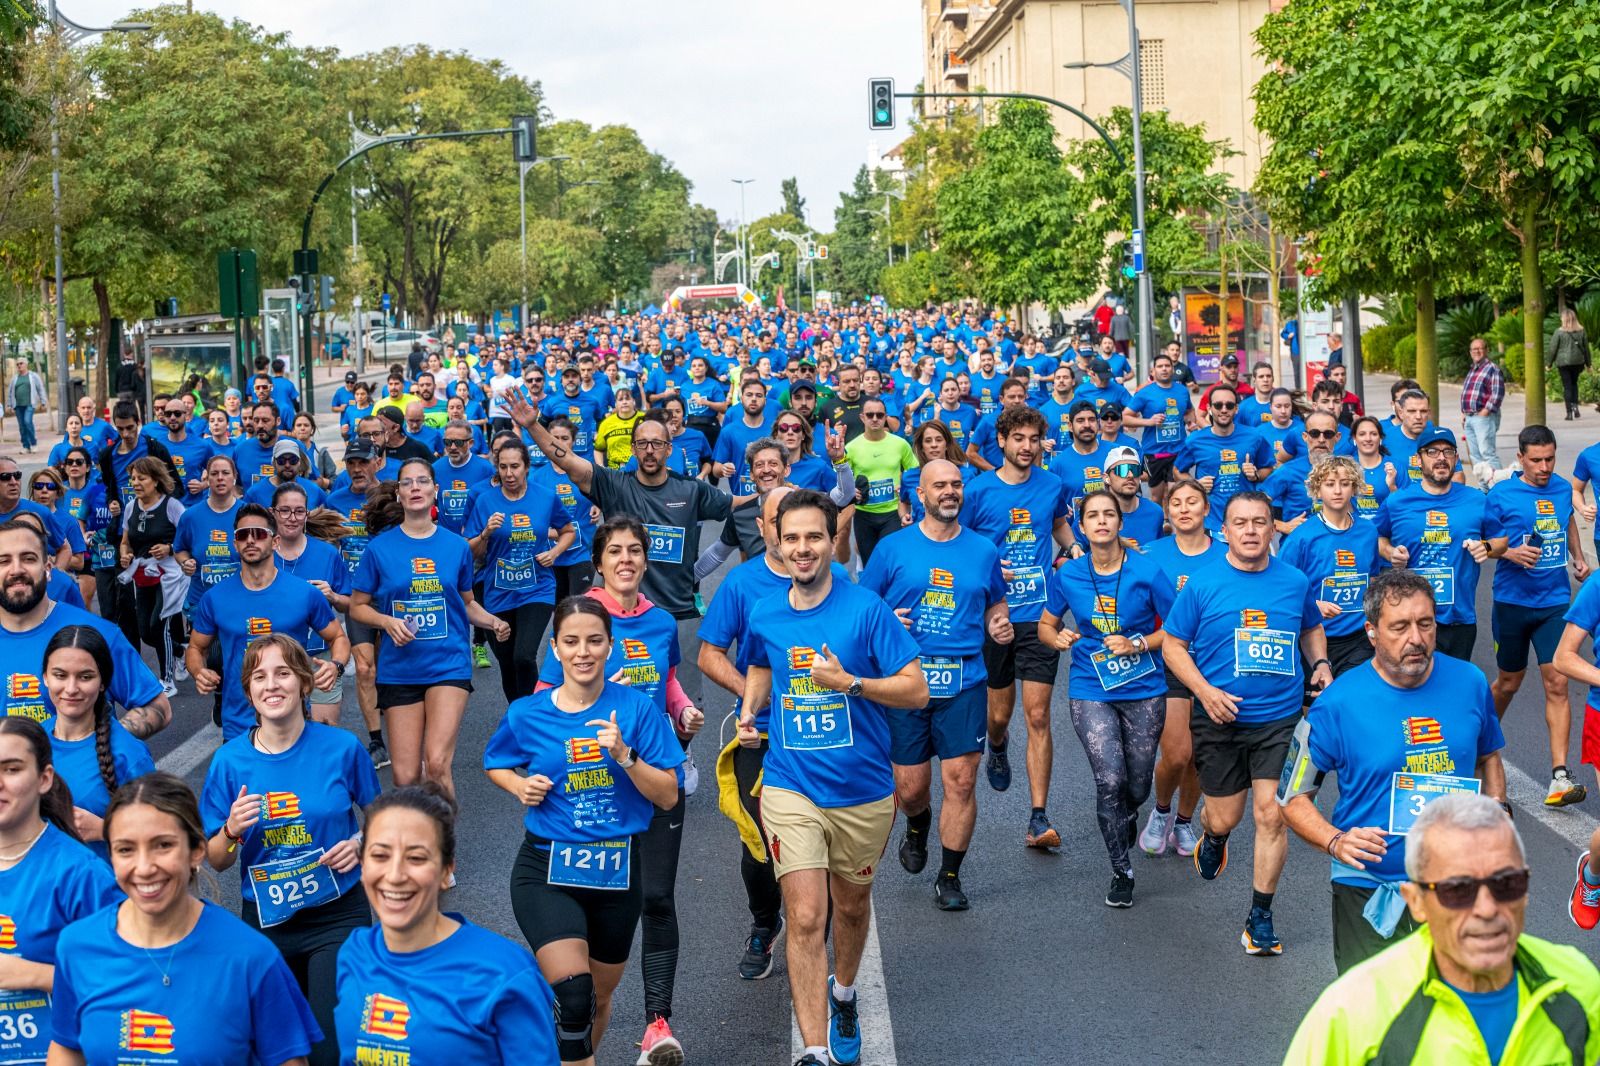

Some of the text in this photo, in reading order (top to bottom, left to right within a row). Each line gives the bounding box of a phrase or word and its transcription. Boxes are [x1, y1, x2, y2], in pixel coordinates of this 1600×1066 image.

[1197, 358, 1210, 368] sky
[1162, 429, 1177, 437] 930
[500, 568, 531, 582] 1066
[1332, 587, 1360, 601] 737
[1249, 643, 1285, 661] 602
[1107, 653, 1141, 675] 969
[793, 713, 836, 733] 115
[568, 767, 608, 783] MUÉVETE
[573, 775, 615, 791] VALENCIA
[265, 824, 306, 840] MUÉVETE
[270, 833, 314, 847] VALENCIA
[560, 848, 621, 870] 1211
[268, 874, 320, 905] 925
[15, 999, 47, 1010] VALENCIA
